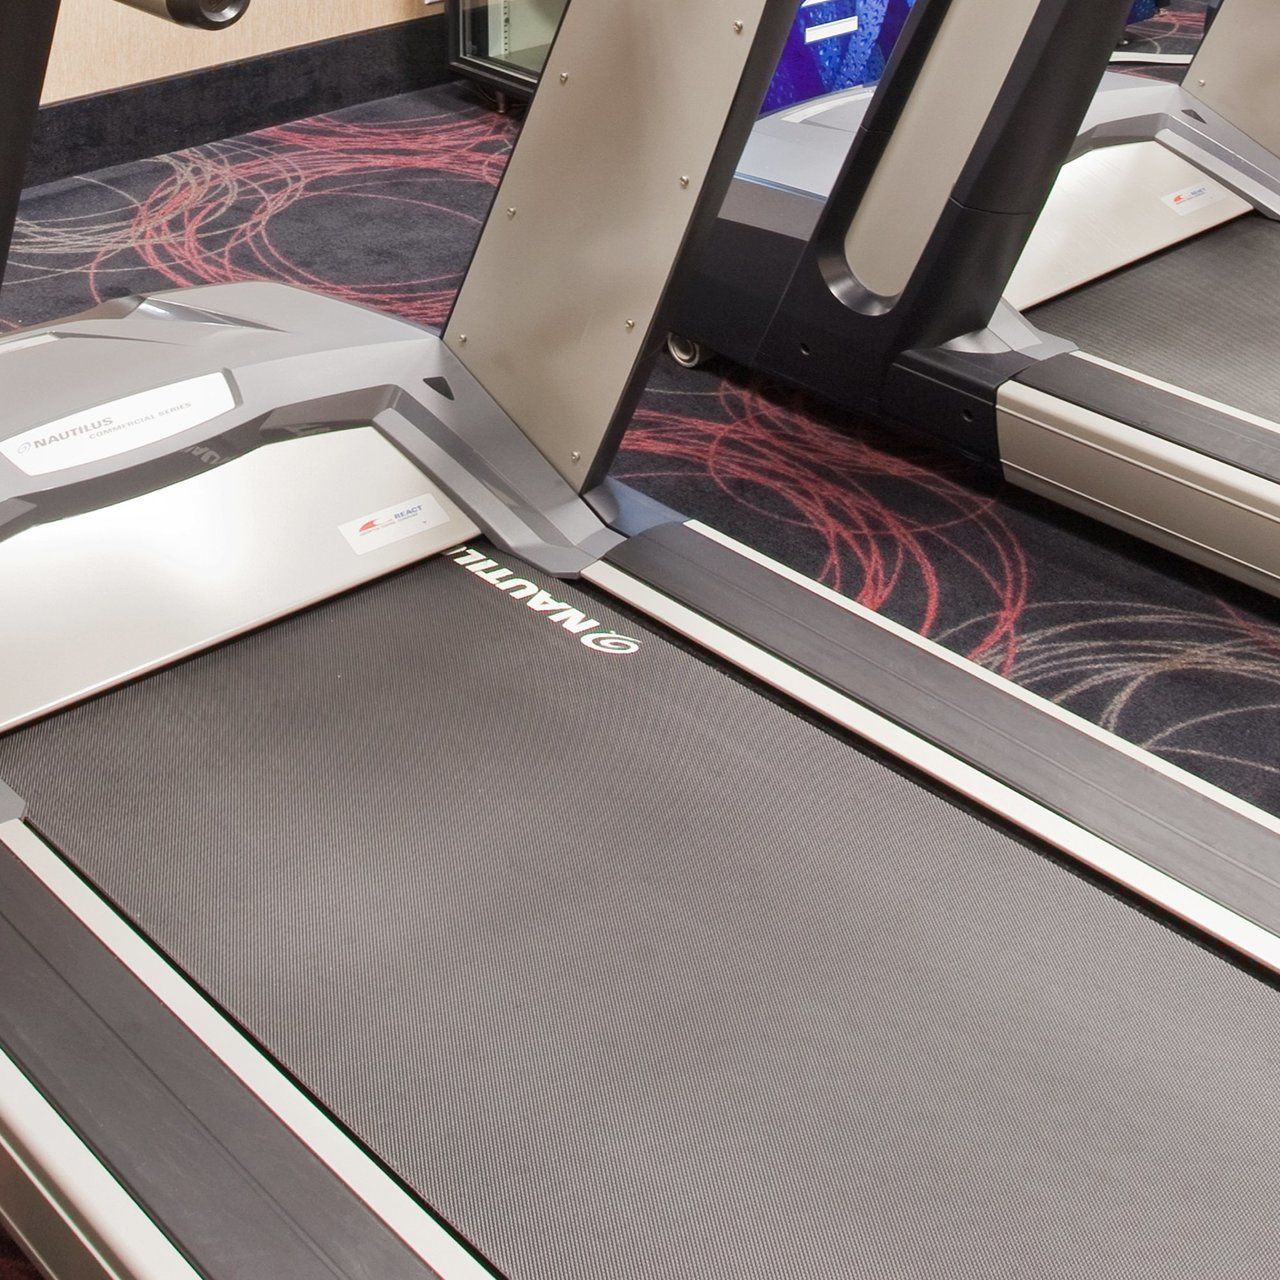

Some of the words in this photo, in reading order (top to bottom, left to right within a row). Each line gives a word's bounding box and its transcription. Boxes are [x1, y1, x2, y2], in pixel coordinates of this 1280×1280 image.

[33, 417, 114, 449] NAUTILUS
[88, 413, 156, 440] COMMERCIAL
[158, 402, 192, 418] SERIES
[442, 546, 601, 634] NAUTIL
